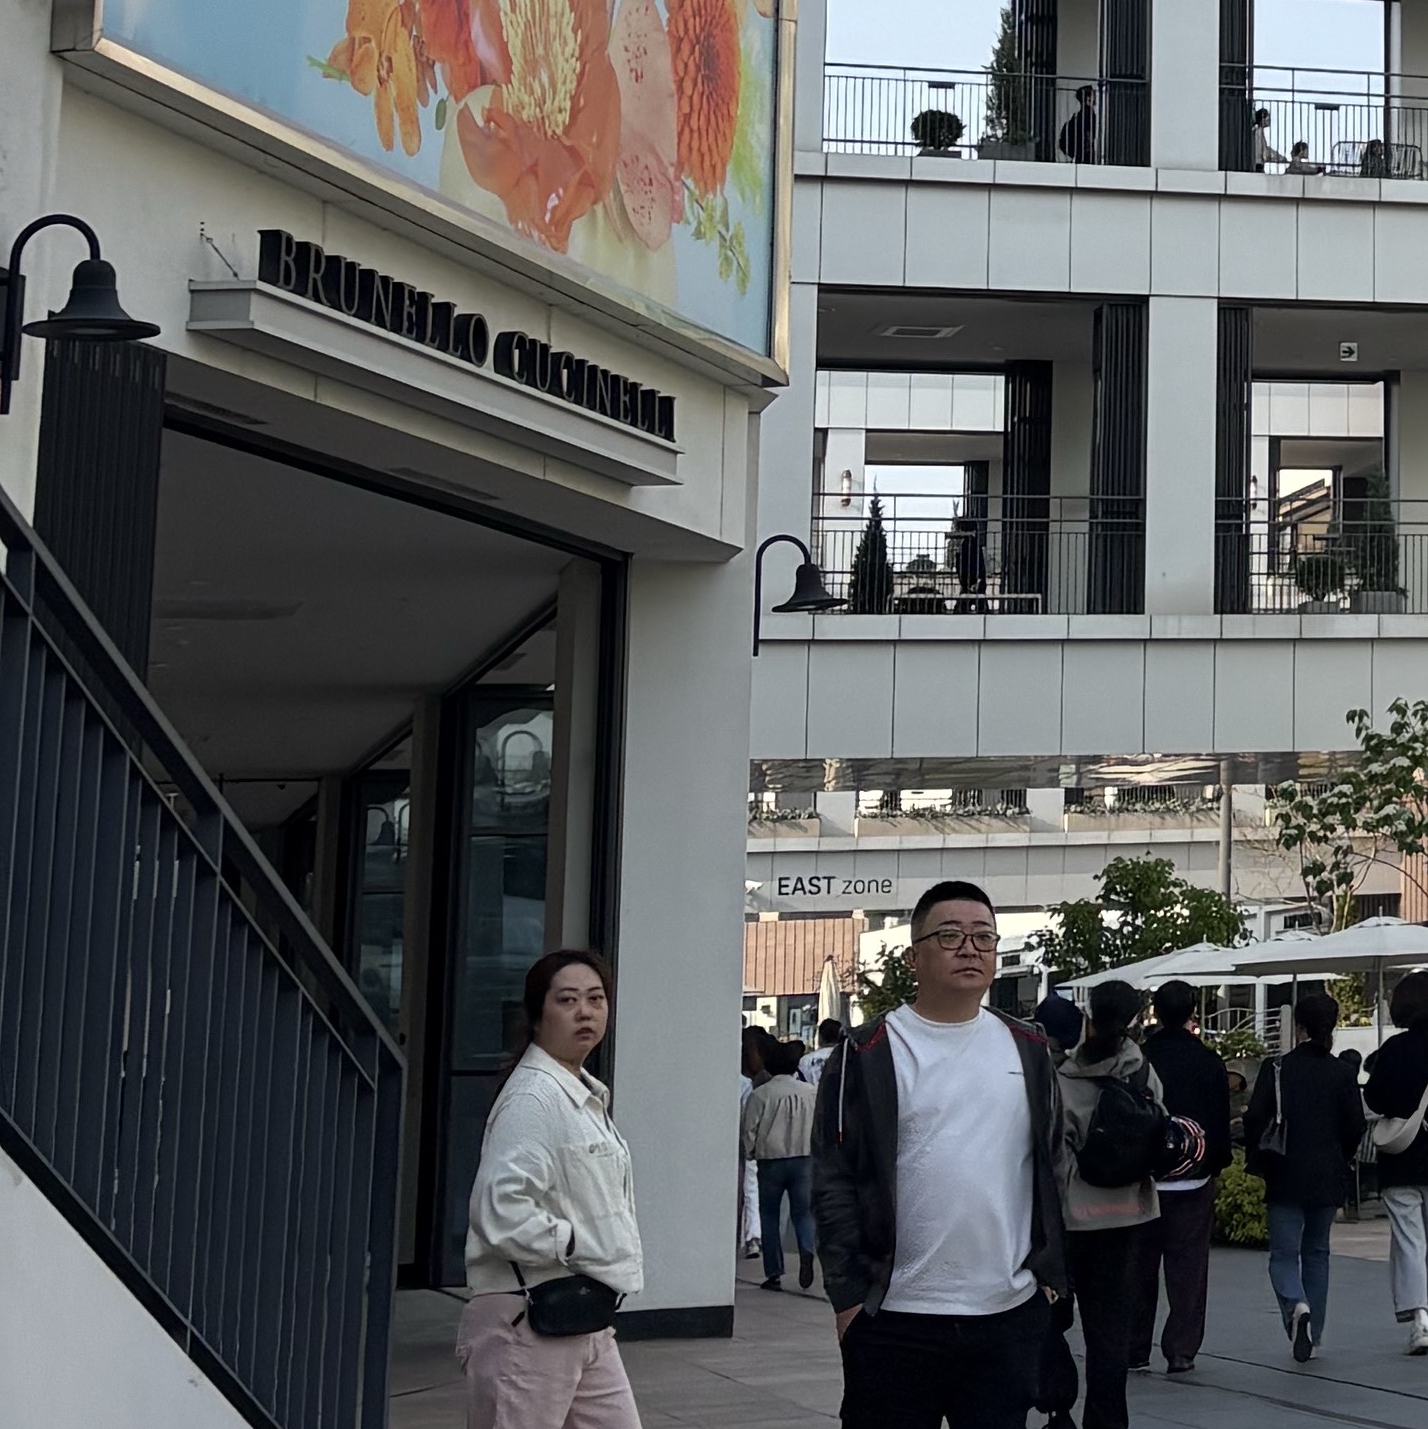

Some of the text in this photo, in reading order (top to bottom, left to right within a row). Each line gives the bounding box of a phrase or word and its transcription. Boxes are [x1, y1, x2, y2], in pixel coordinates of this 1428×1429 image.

[258, 229, 678, 443] BRUNELLO CUCINELLI
[777, 875, 893, 896] EAST zone
